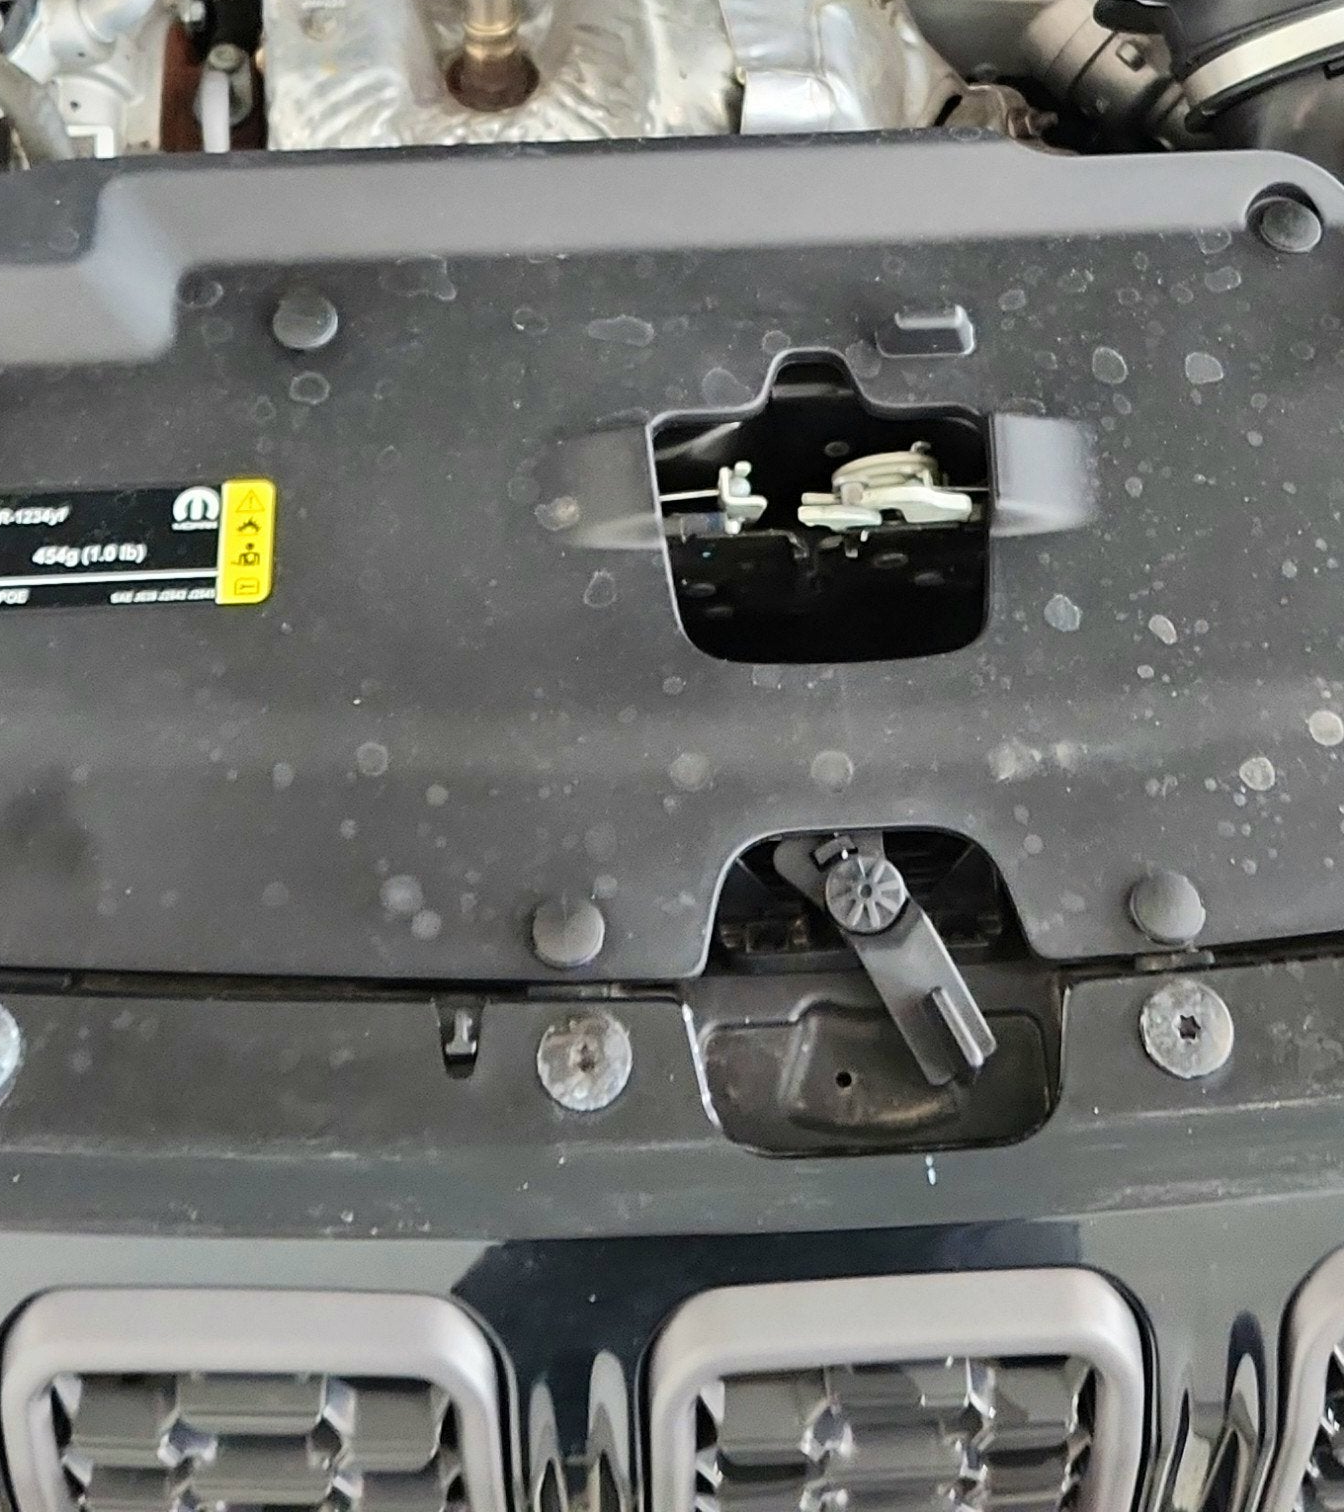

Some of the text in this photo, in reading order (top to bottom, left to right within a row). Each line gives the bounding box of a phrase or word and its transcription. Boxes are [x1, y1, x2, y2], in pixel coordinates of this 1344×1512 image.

[32, 543, 147, 568] 454g (1.0 lb)
